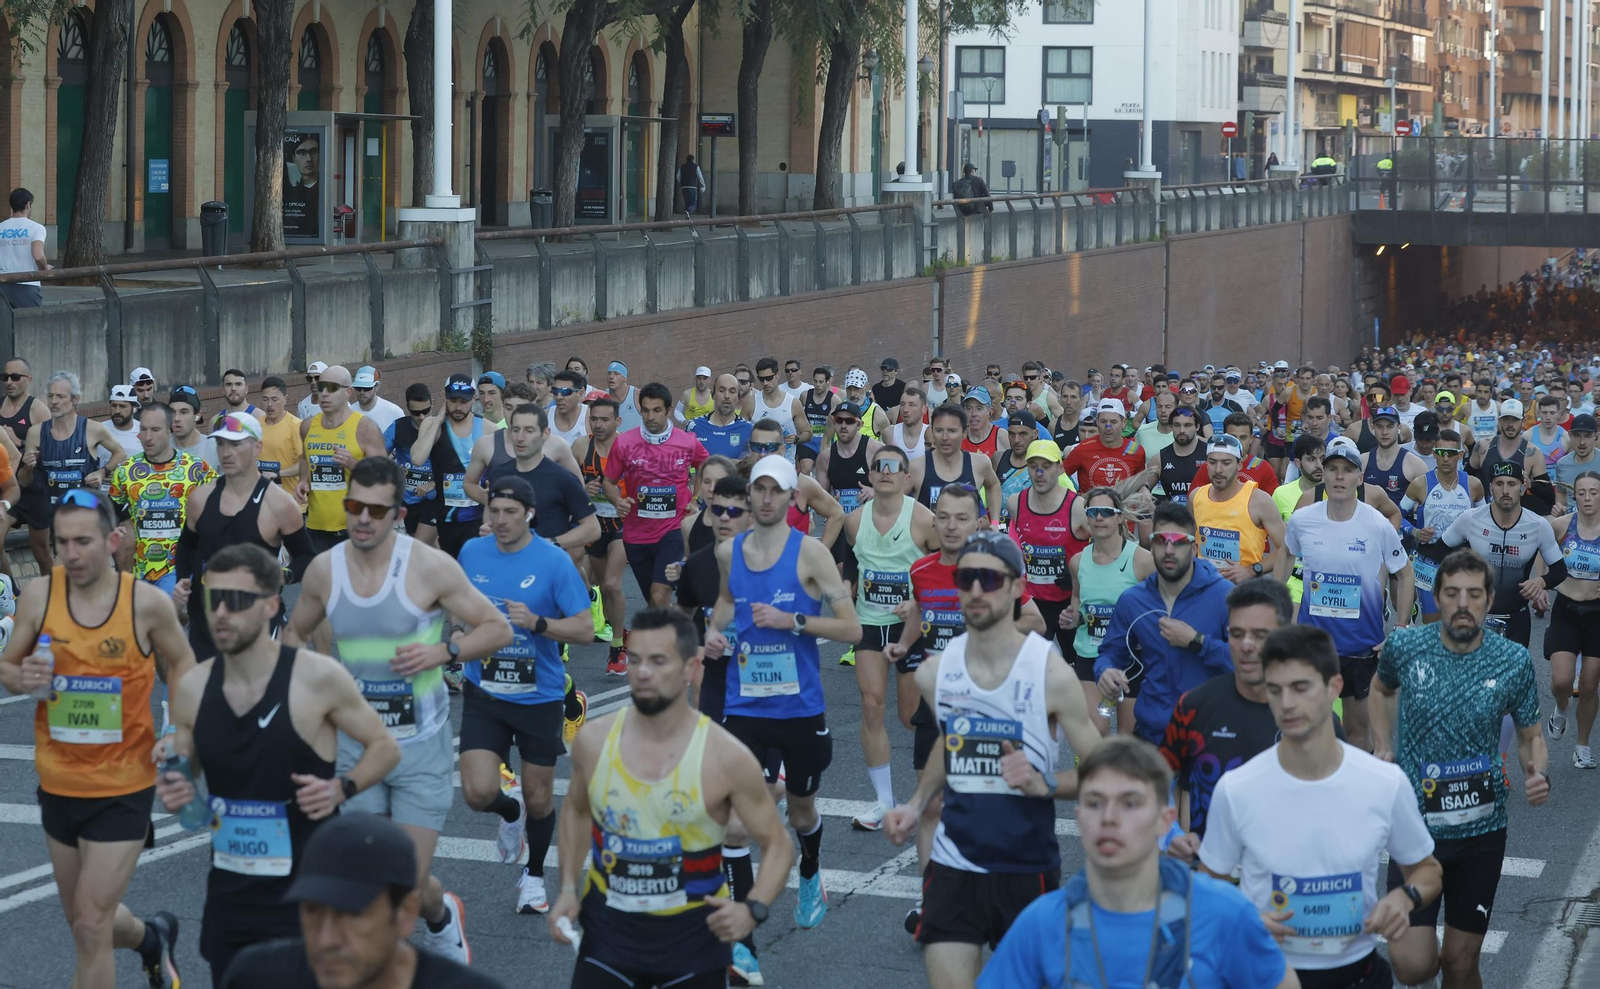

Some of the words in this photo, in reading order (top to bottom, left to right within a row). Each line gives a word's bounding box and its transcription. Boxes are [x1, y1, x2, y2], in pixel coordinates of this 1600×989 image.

[307, 442, 346, 451] SWEDEN
[143, 519, 176, 529] RESOMA
[1206, 548, 1232, 559] VICTOR
[1579, 544, 1600, 554] ZURICH
[1027, 565, 1047, 575] PACO
[1573, 561, 1590, 571] LORI
[877, 572, 903, 580] ZURICH
[869, 592, 903, 604] MATTEO
[1322, 596, 1348, 607] CYRIL
[754, 644, 786, 653] ZURICH
[934, 638, 951, 650] JOH
[494, 670, 520, 682] ALEX
[751, 672, 782, 683] STIJN
[71, 679, 113, 690] ZURICH
[367, 684, 405, 693] ZURICH
[68, 713, 99, 726] IVAN
[975, 723, 1015, 735] ZURICH
[1445, 762, 1482, 774] ZURICH
[1441, 792, 1480, 811] ISAAC
[230, 804, 276, 816] ZURICH
[228, 840, 268, 855] HUGO
[626, 842, 672, 854] ZURICH
[608, 874, 679, 893] ROBERTO
[1302, 879, 1352, 893] ZURICH
[1303, 905, 1330, 915] 6489
[1298, 924, 1361, 937] UELCASTILLO
